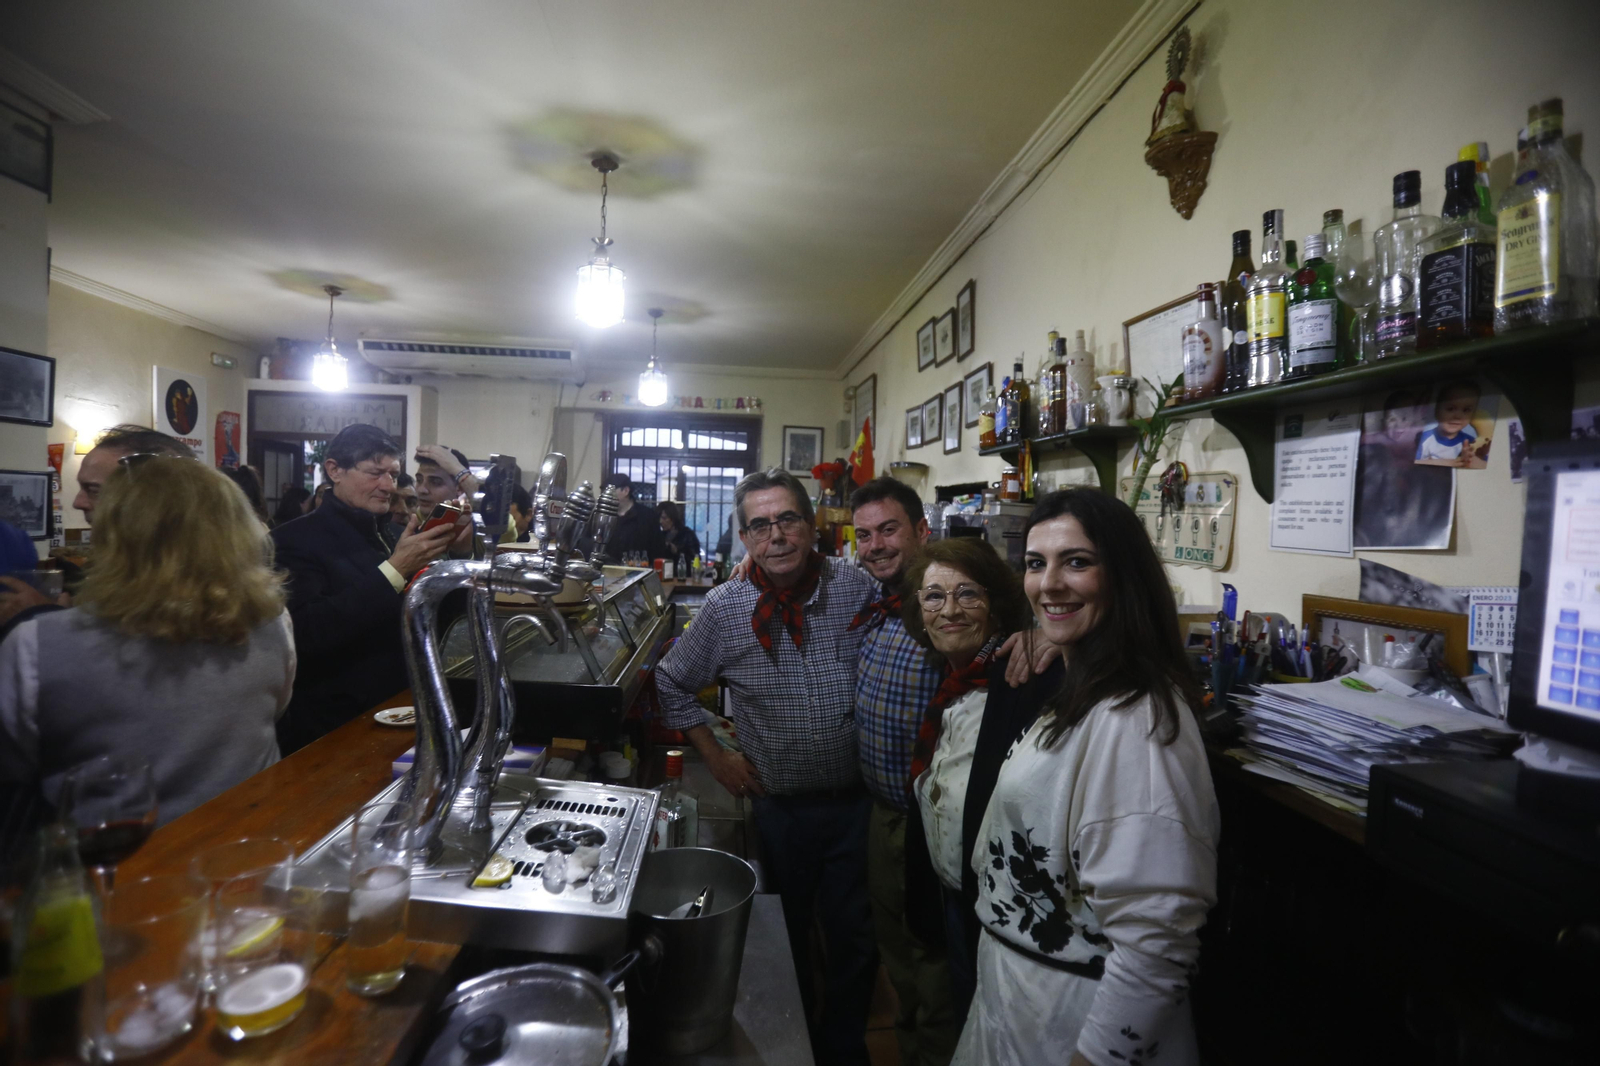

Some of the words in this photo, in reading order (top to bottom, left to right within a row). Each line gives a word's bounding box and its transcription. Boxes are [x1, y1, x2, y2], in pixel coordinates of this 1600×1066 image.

[1505, 239, 1525, 252] DRY
[1184, 547, 1214, 563] ONCE
[1486, 621, 1494, 629] 10
[1497, 630, 1505, 638] 18
